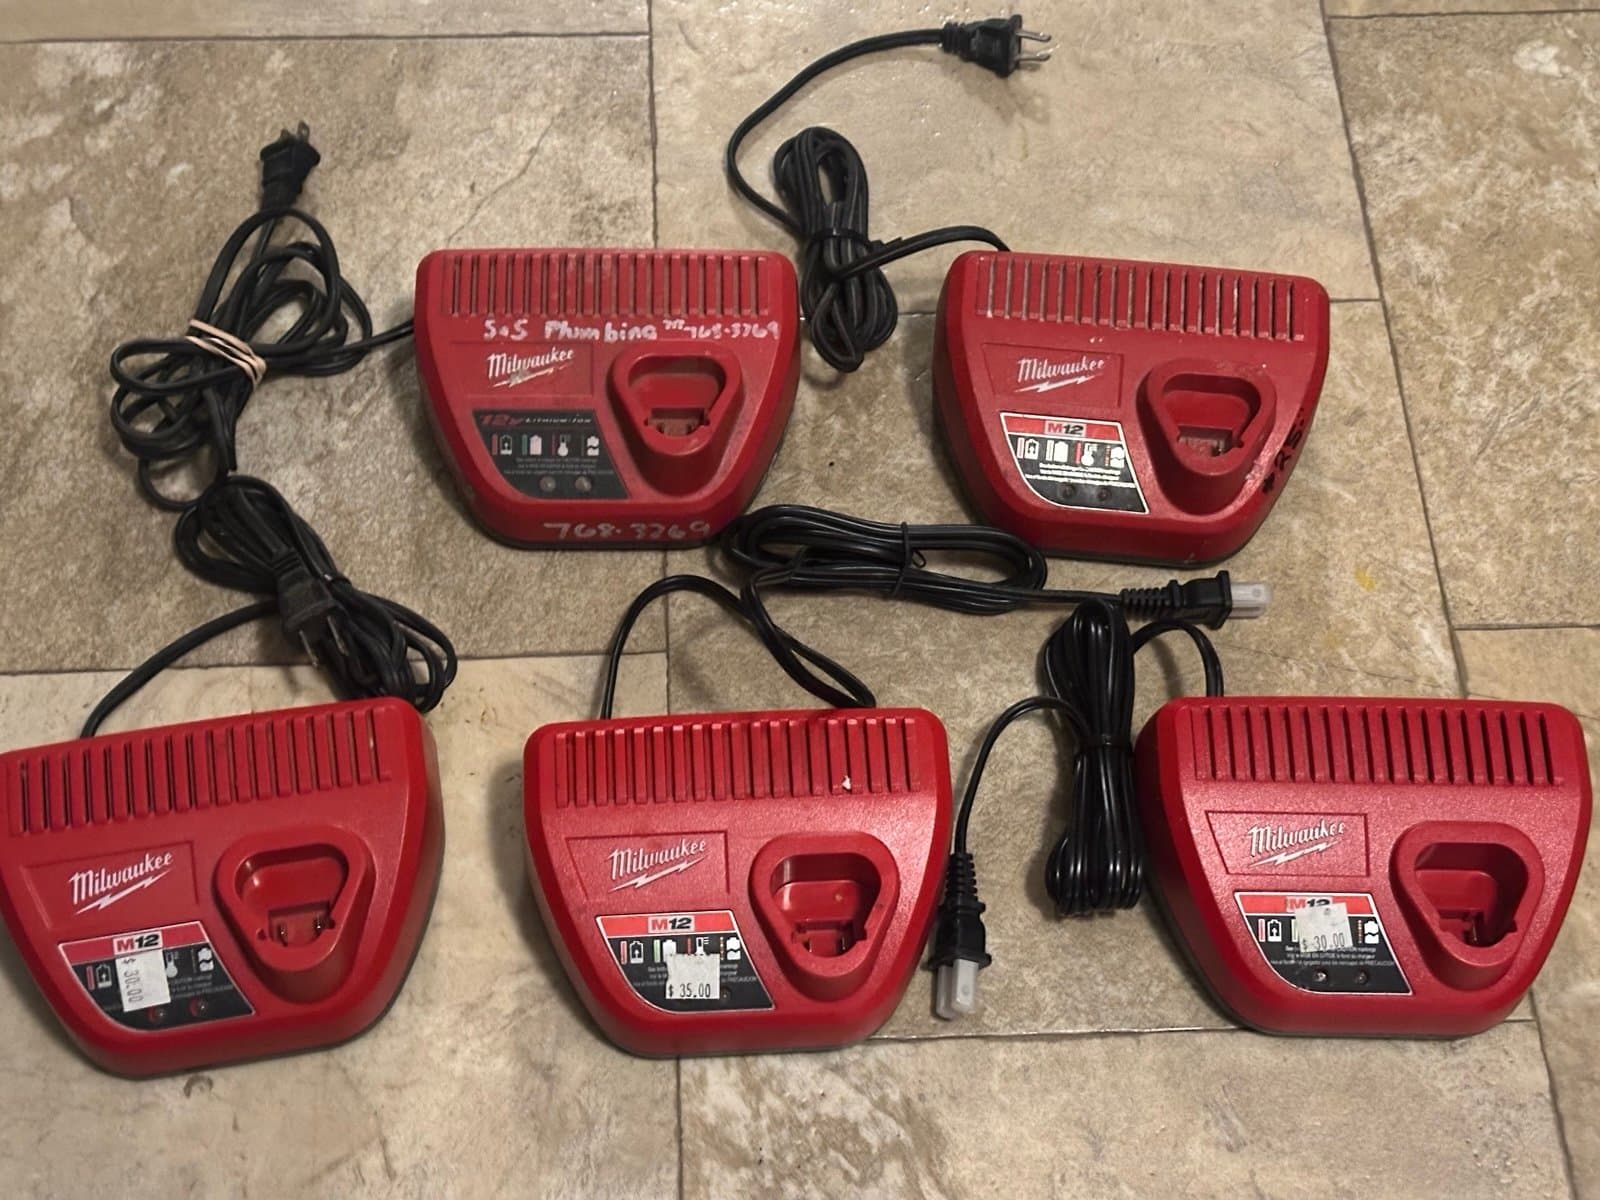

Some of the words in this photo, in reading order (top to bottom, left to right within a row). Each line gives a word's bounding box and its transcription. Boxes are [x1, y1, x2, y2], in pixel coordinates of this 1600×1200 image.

[487, 346, 575, 379] Milwaukee
[1018, 356, 1105, 382] Milwaukee
[1047, 421, 1084, 436] M12
[1248, 819, 1345, 858] Milwaukee
[607, 838, 706, 881] Milwaukee
[68, 852, 173, 905] Milwaukee
[651, 917, 692, 931] M12
[117, 934, 160, 952] M12
[680, 983, 711, 999] 35.00
